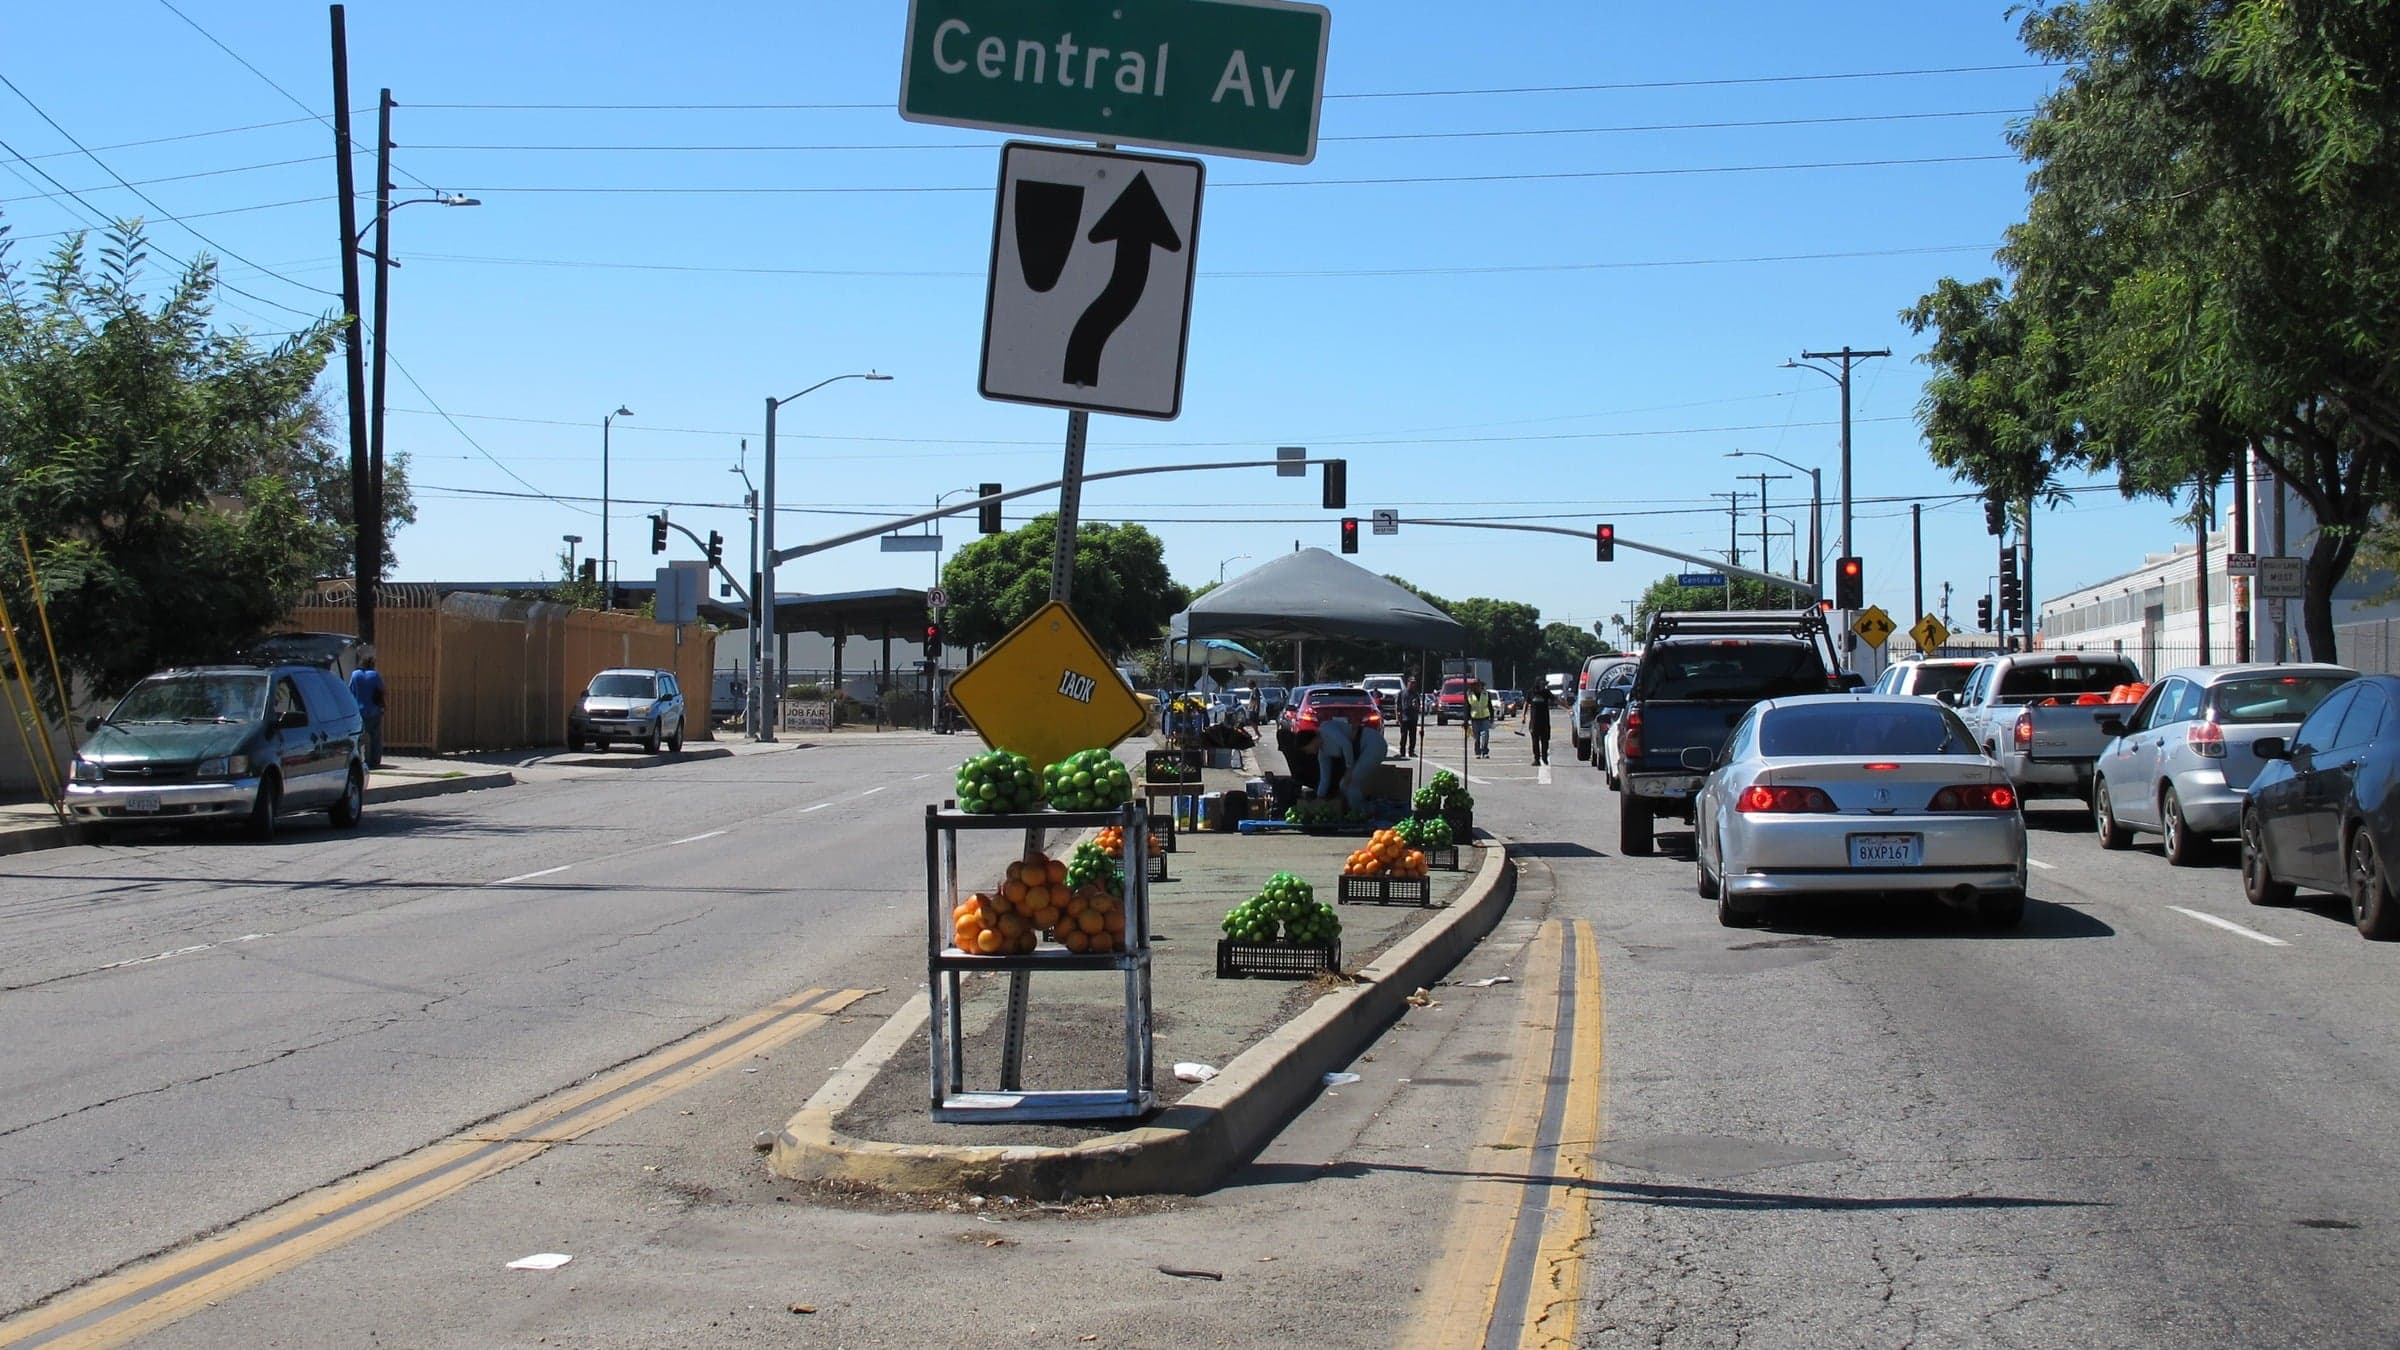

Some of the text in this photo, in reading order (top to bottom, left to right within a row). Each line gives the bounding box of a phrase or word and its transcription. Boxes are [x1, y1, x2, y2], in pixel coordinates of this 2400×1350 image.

[932, 18, 1295, 110] Central Av
[786, 708, 825, 718] JOB FAIR
[1860, 846, 1909, 860] 8XXP167
